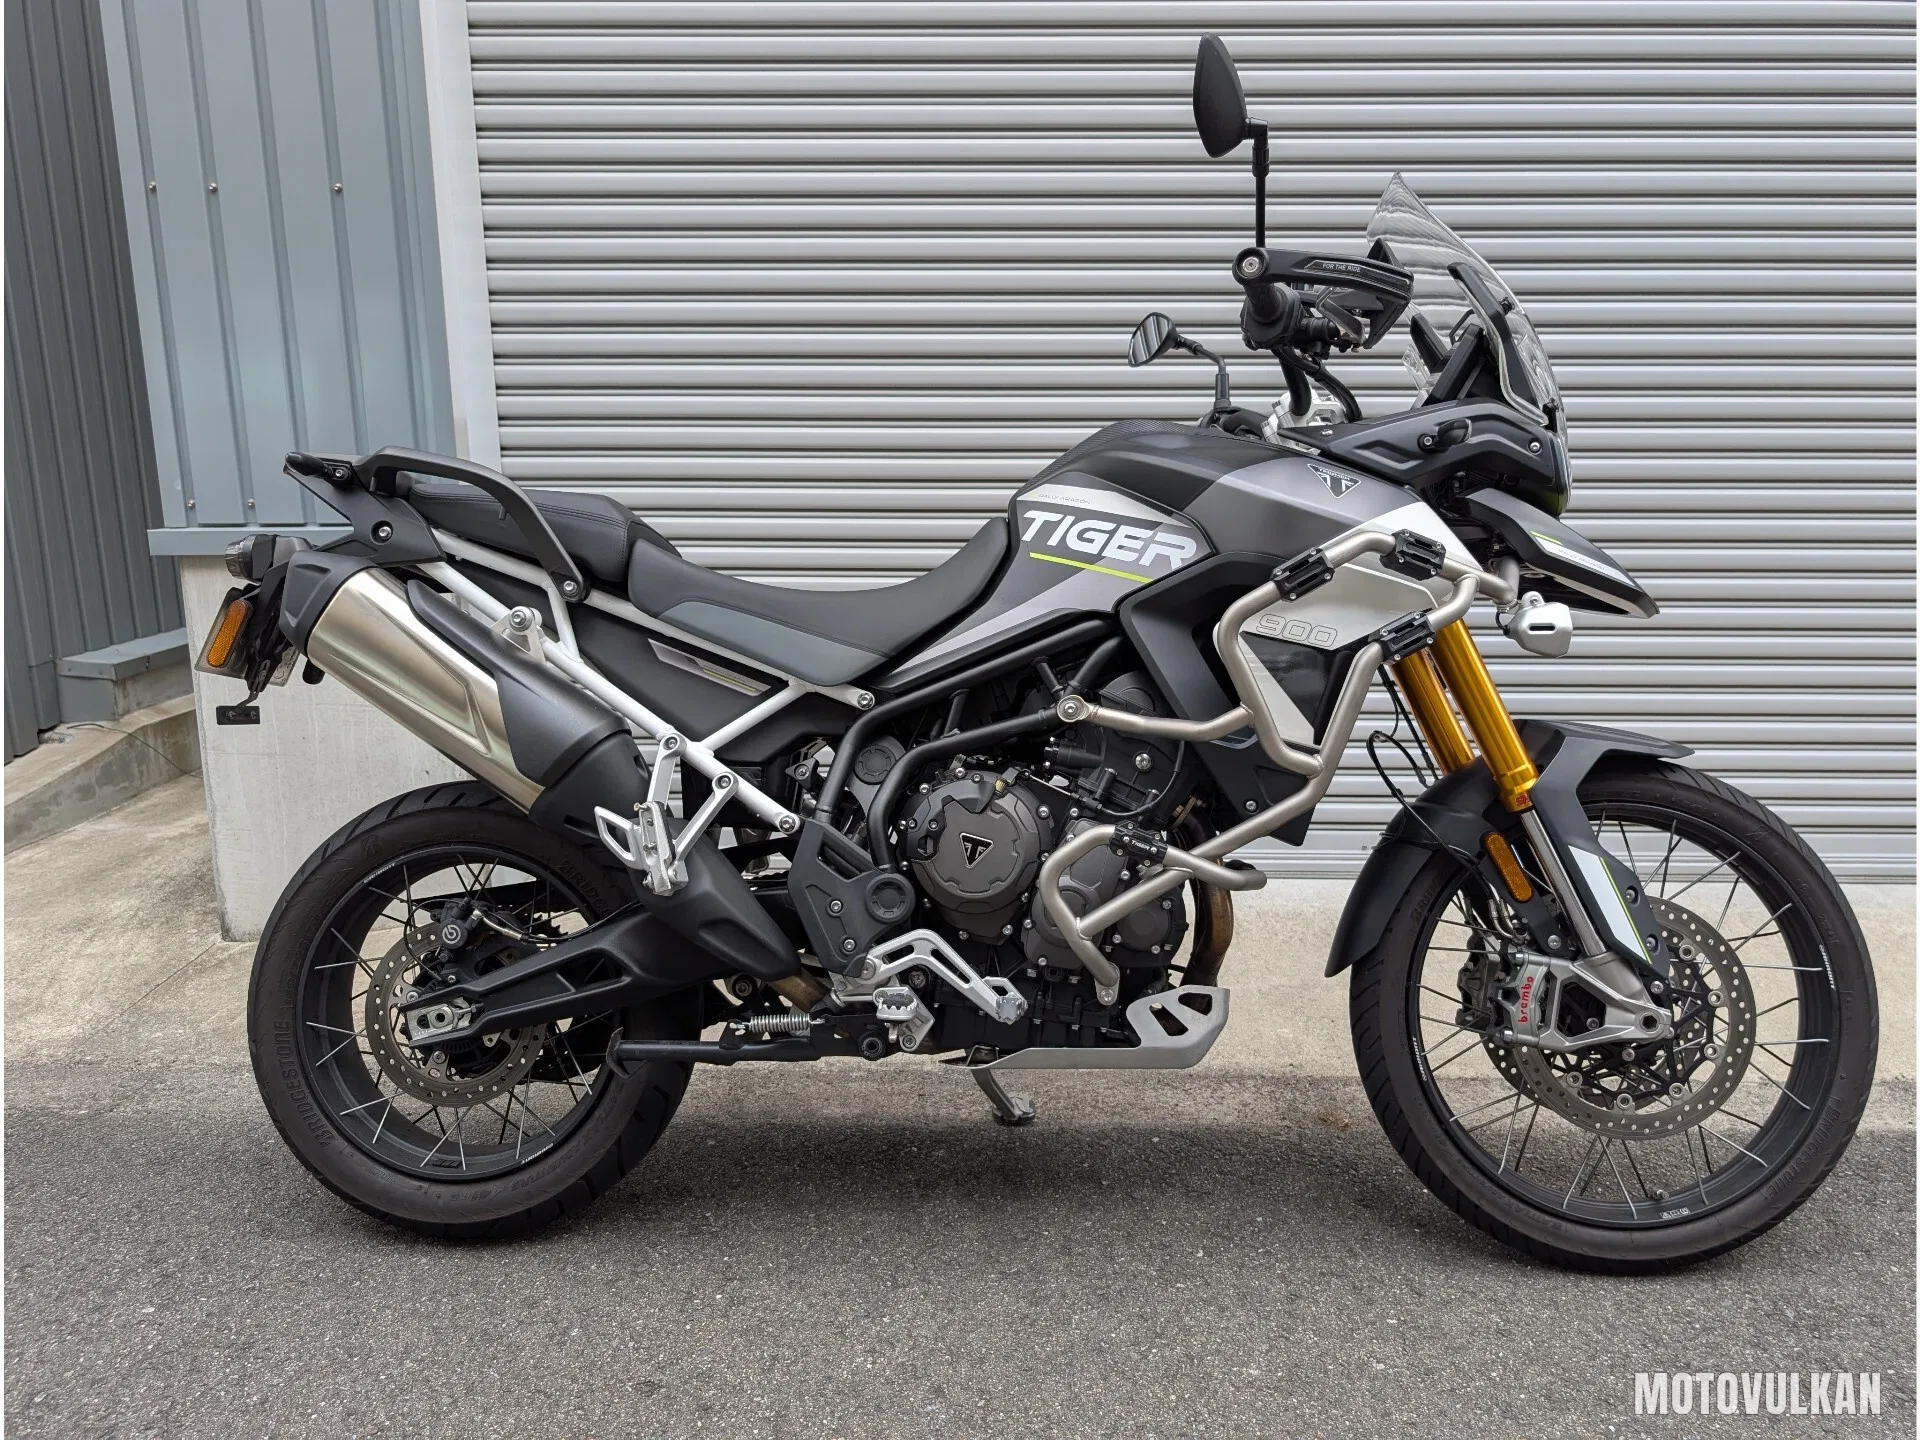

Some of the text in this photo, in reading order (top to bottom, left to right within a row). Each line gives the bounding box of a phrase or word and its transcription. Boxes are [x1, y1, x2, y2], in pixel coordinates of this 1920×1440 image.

[1322, 262, 1361, 273] FOR THE RIDE
[1020, 509, 1197, 571] TIGER
[1256, 613, 1338, 648] 900
[1517, 975, 1535, 1024] brembo
